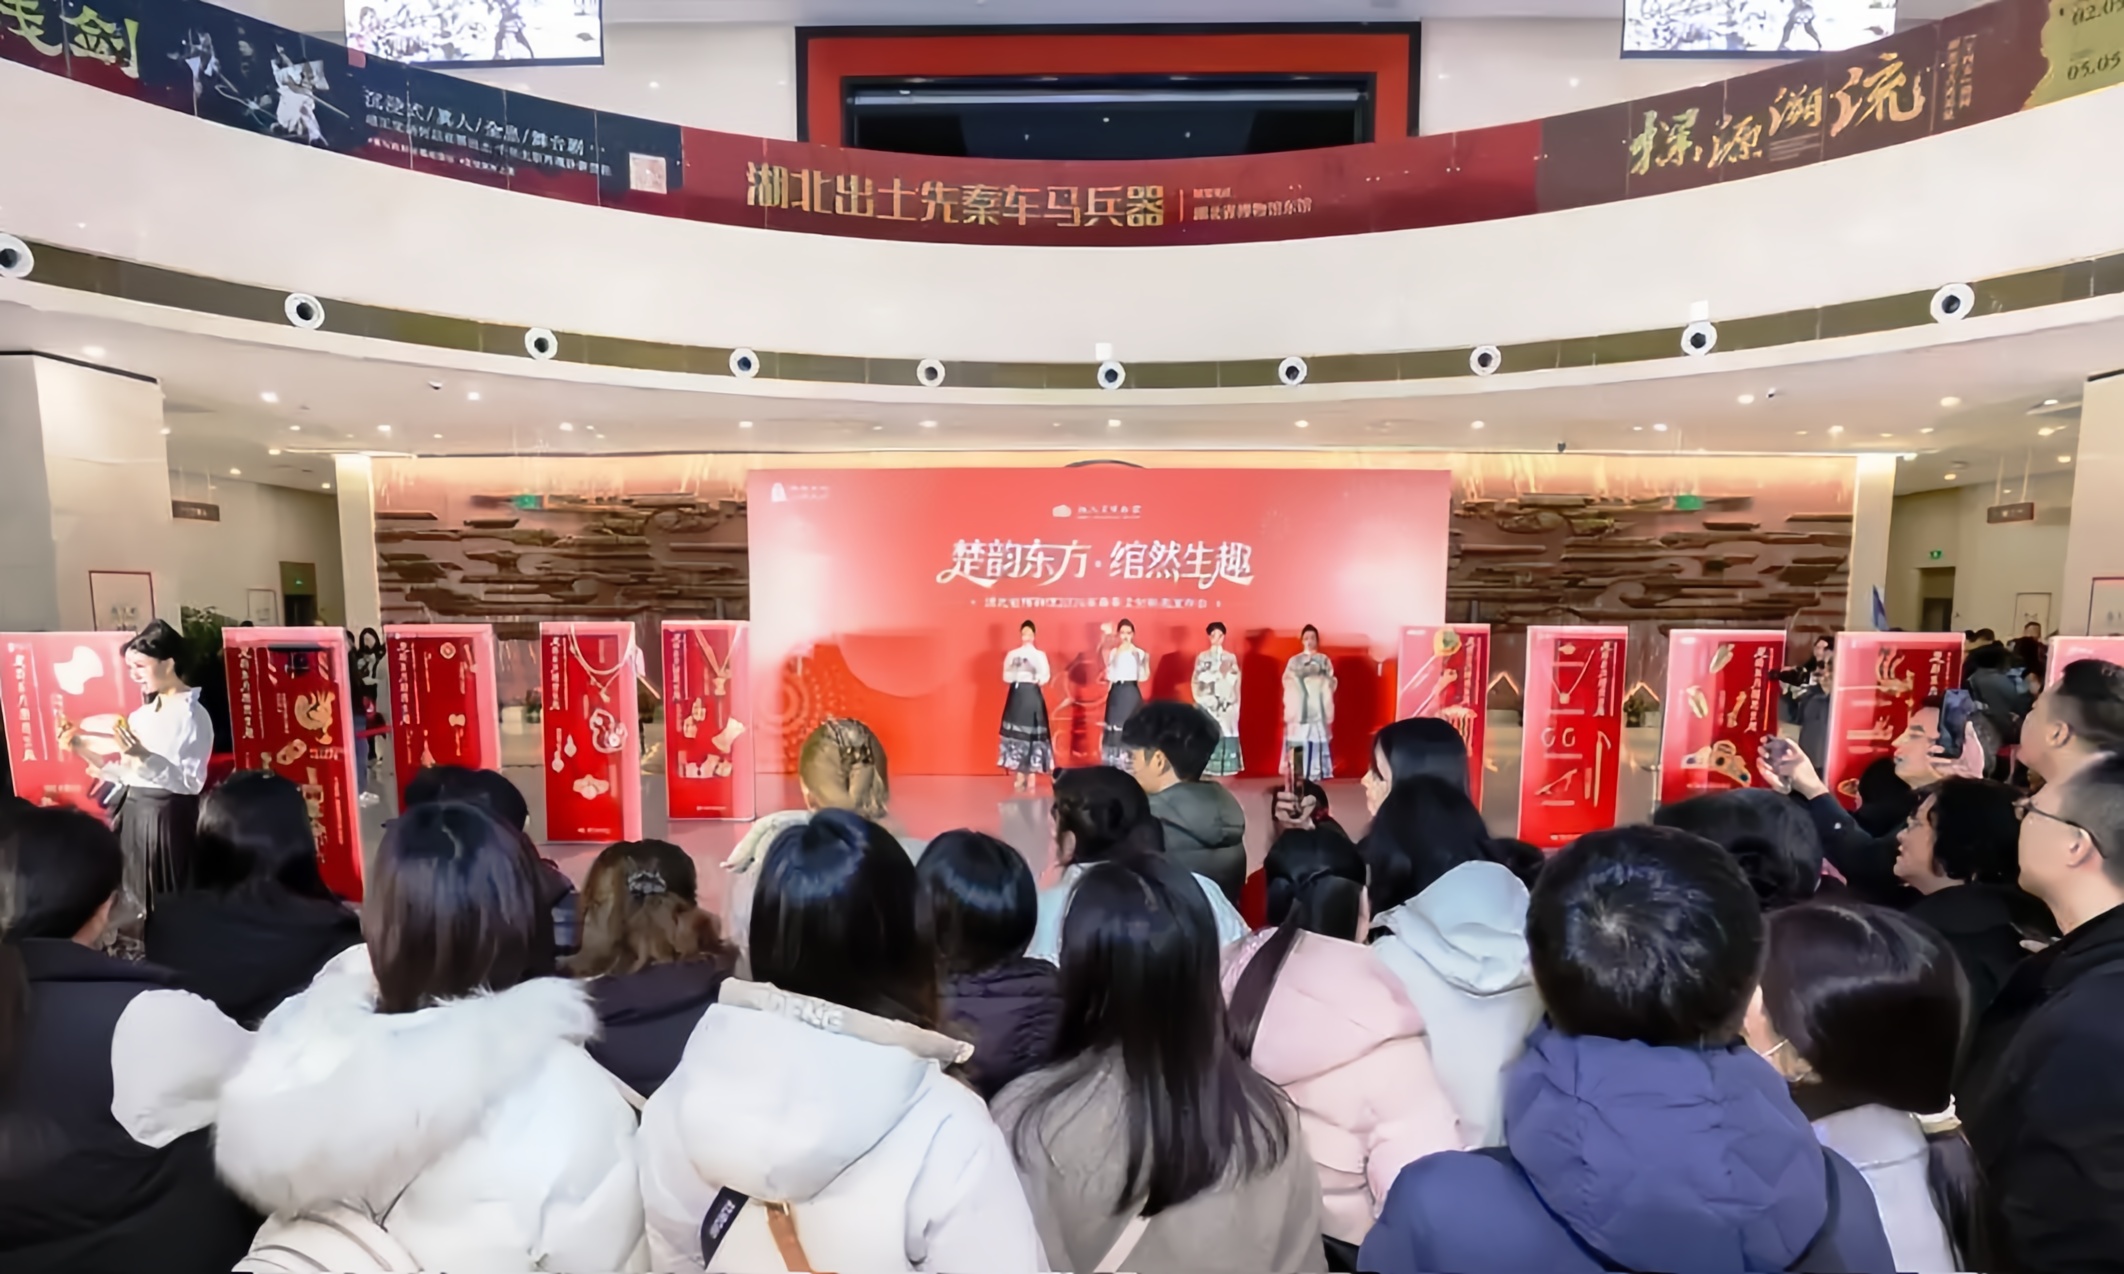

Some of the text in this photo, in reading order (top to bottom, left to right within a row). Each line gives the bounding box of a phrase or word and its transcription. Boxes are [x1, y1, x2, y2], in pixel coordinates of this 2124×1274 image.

[2067, 50, 2121, 80] 05.05
[746, 160, 1165, 228] 湖北出土先秦车马兵器
